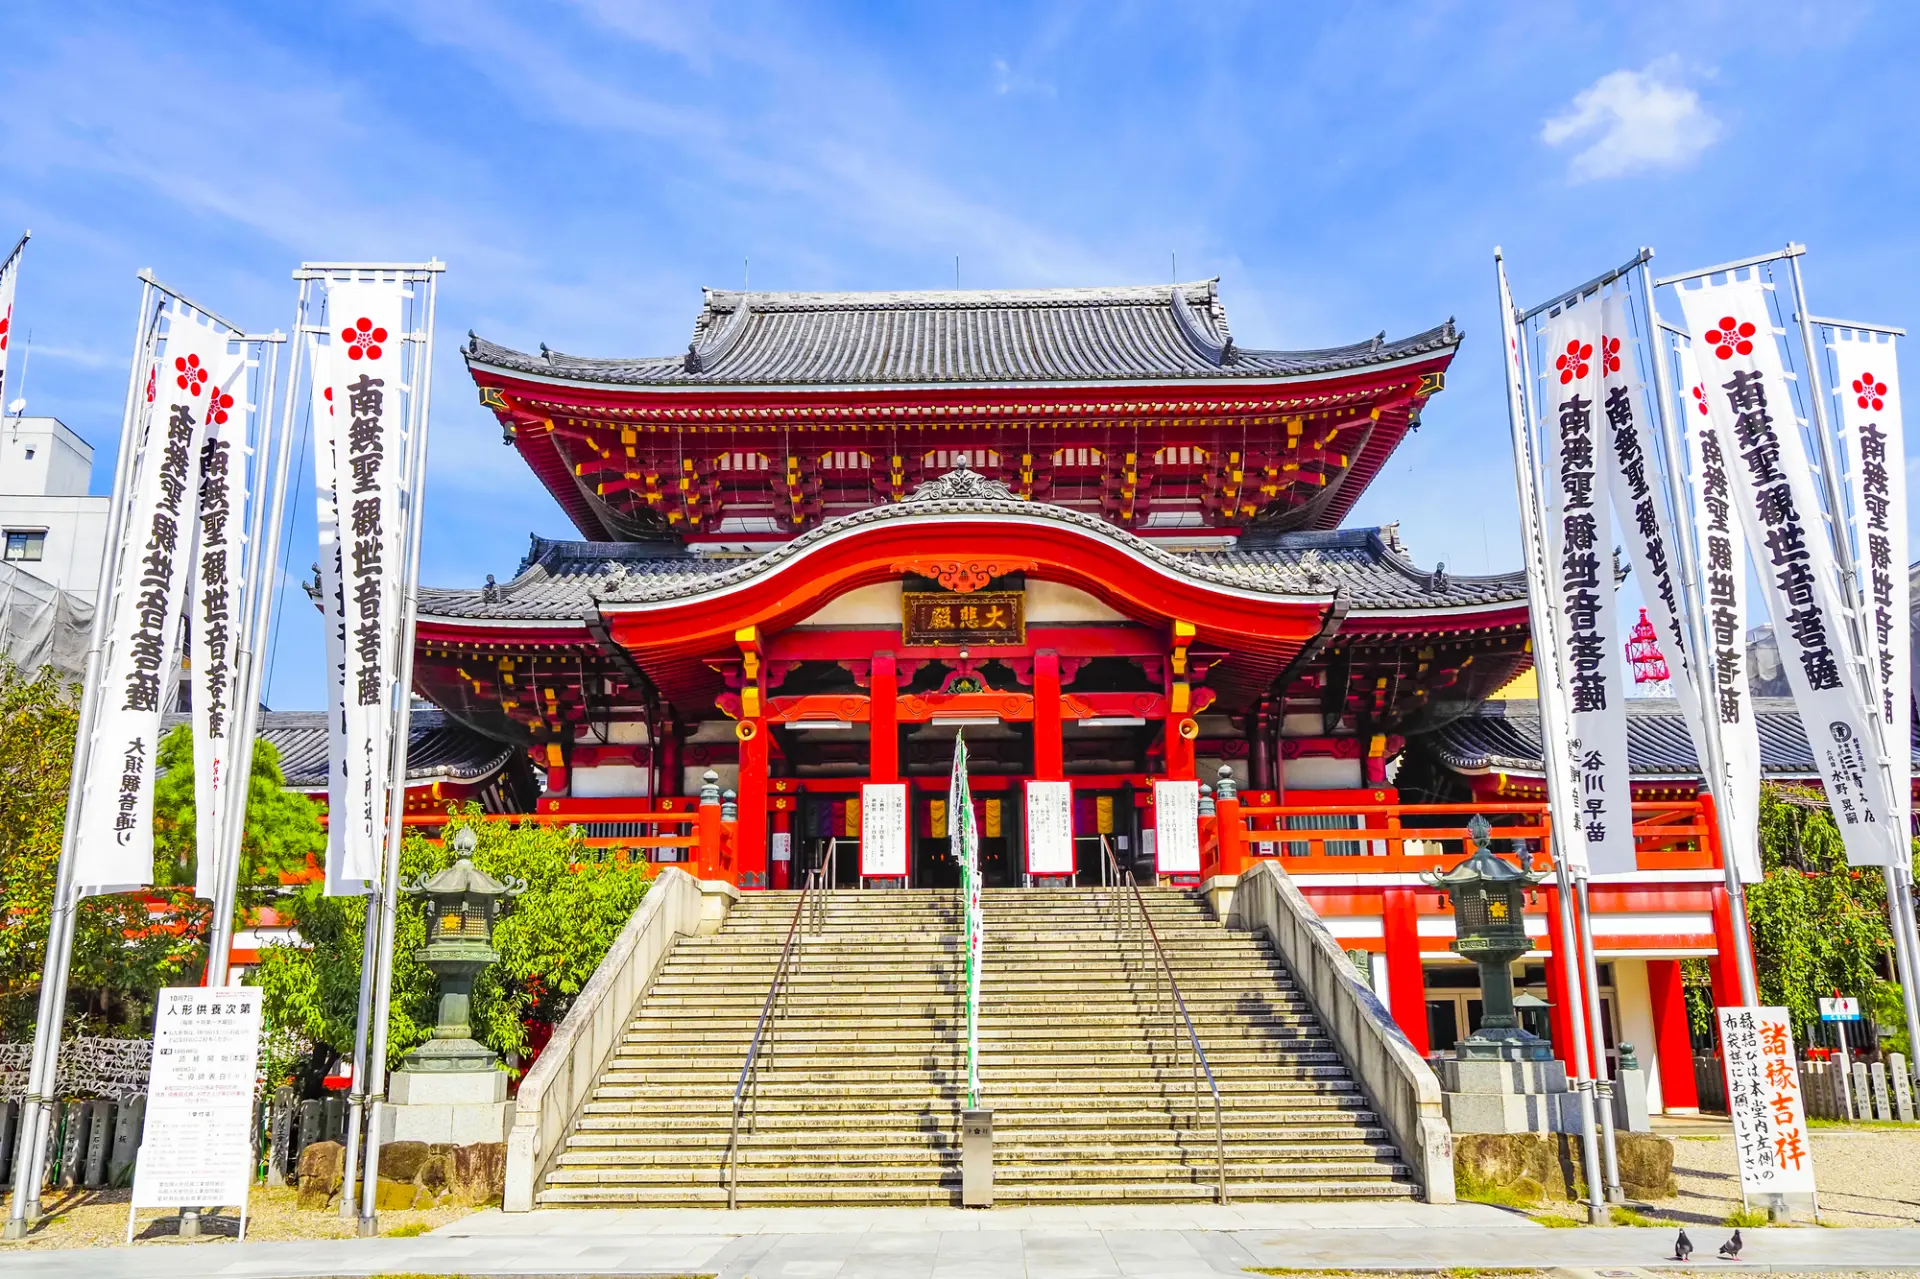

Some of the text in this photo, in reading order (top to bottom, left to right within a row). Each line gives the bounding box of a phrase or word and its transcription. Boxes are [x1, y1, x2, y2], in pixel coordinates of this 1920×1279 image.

[347, 374, 385, 706] 南無聖観世音菩薩
[1722, 370, 1843, 691] 南無聖観世音菩薩
[167, 1003, 251, 1016] 人形供養次第
